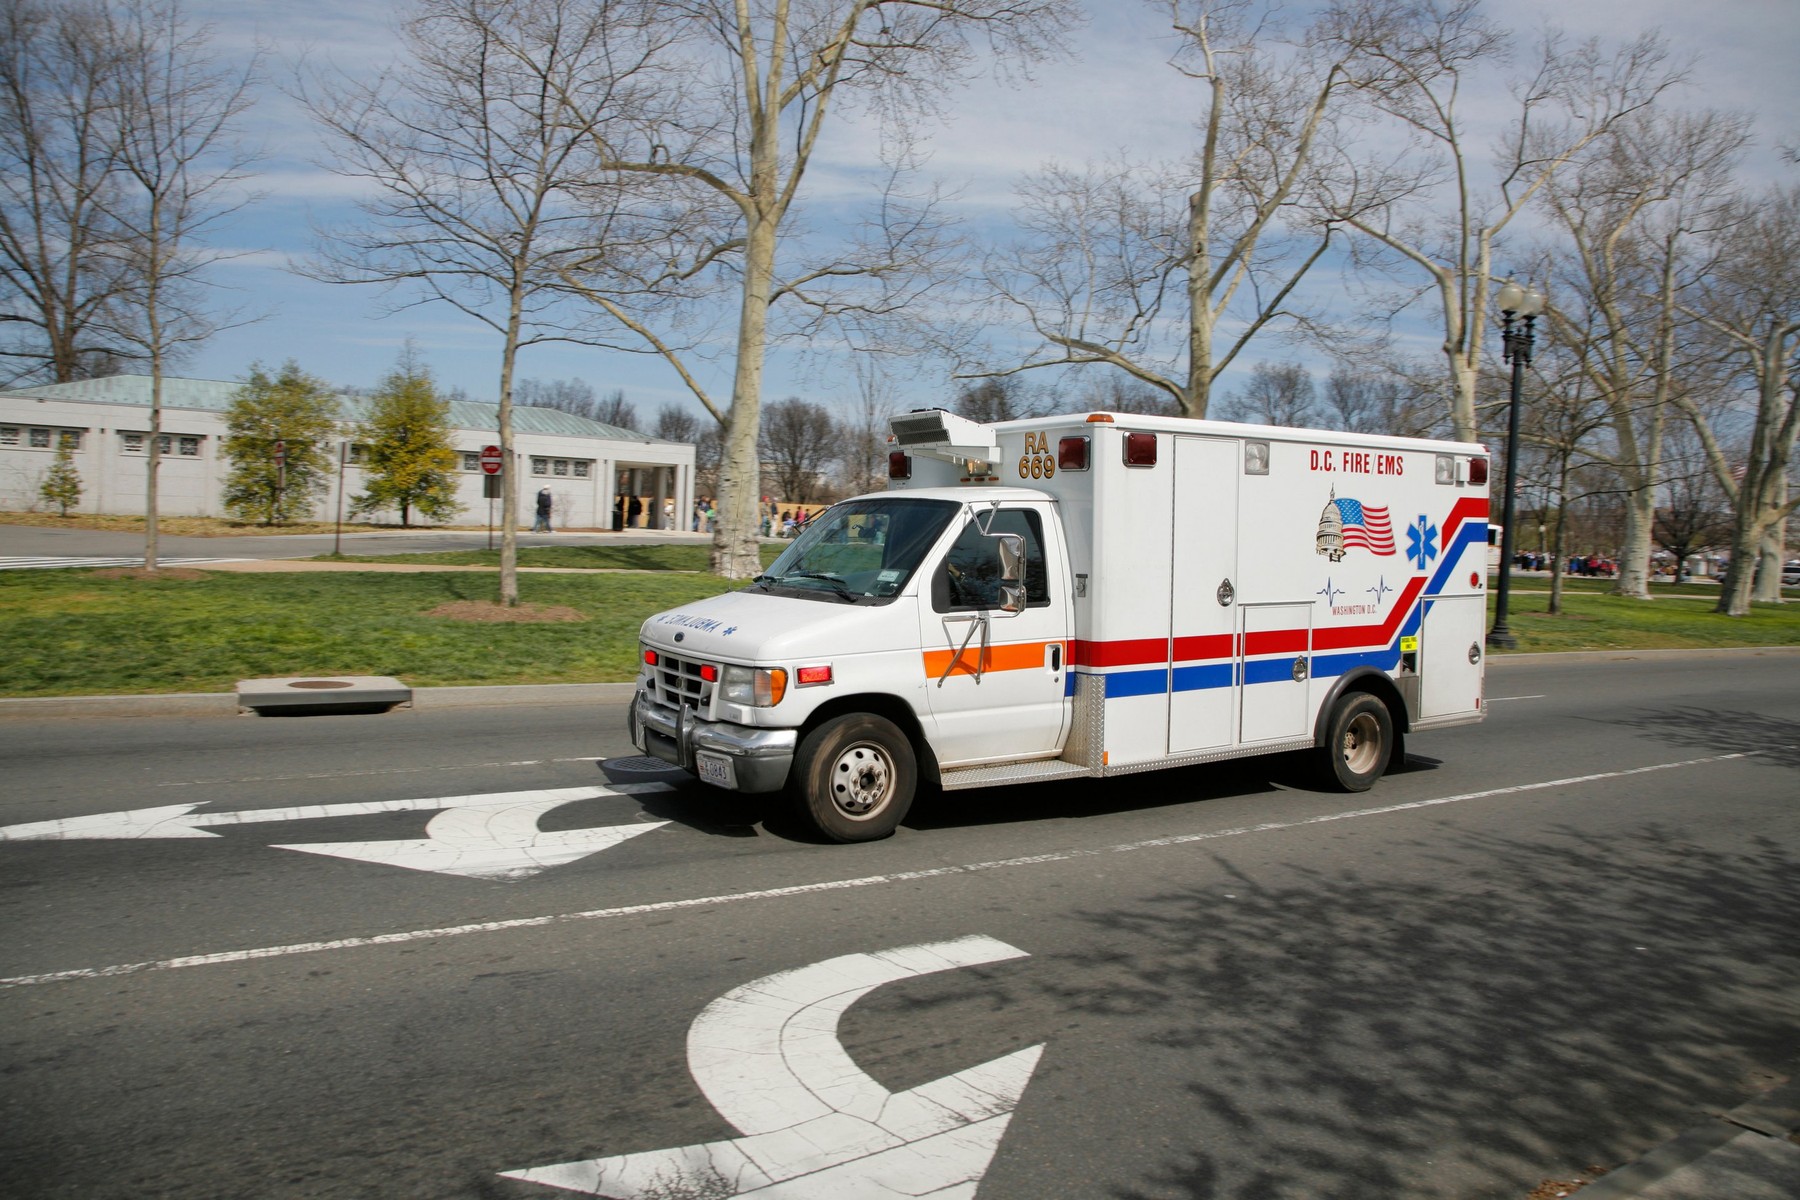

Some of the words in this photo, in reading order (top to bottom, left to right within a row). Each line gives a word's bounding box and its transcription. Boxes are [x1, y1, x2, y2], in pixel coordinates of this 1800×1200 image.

[1025, 431, 1049, 454] RA
[1018, 455, 1055, 479] 669
[1311, 450, 1336, 471] D.C.
[1343, 452, 1403, 476] FIRE/EMS
[1332, 605, 1365, 616] WASHINGTON
[1367, 604, 1377, 614] D.C.
